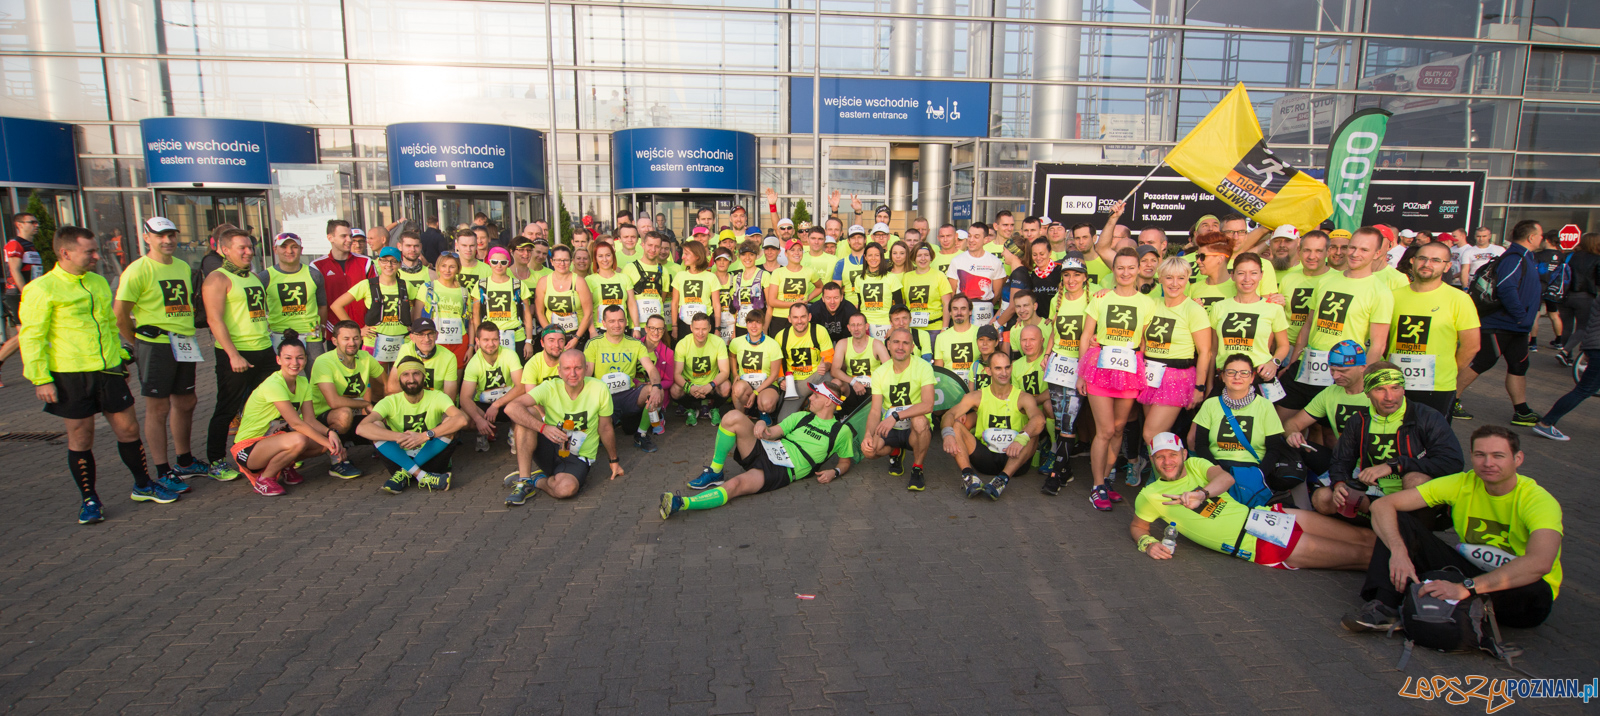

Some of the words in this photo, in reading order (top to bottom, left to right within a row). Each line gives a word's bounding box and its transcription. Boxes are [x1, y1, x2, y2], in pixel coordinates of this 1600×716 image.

[824, 95, 862, 109] wejście
[864, 97, 919, 109] wschodnie
[1280, 102, 1306, 115] RETRO
[839, 110, 871, 119] eastern
[872, 111, 908, 120] entrance
[148, 138, 182, 154] wejście
[185, 139, 260, 153] wschodnie
[400, 143, 437, 158] wejście
[440, 144, 506, 157] wschodnie
[635, 147, 674, 162] wejście
[677, 147, 734, 161] wschodnie
[160, 155, 195, 166] eastern
[197, 155, 247, 166] entrance
[414, 159, 449, 169] eastern
[450, 160, 495, 169] entrance
[650, 163, 684, 173] eastern
[686, 164, 724, 173] entrance
[1336, 131, 1379, 217] 4:00
[1236, 176, 1267, 197] night
[1143, 192, 1180, 200] Pozostaw
[1180, 192, 1198, 202] swój
[1199, 193, 1215, 201] ślad
[1221, 178, 1266, 210] runners
[1065, 201, 1075, 209] 18.
[1076, 201, 1093, 209] PKO
[1216, 184, 1259, 216] GLIWICE
[1151, 202, 1186, 210] Poznaniu
[1376, 203, 1396, 214] posir
[1560, 233, 1579, 241] STOP
[253, 310, 266, 318] nigh
[1320, 320, 1339, 329] night
[440, 326, 459, 335] 5397
[1111, 328, 1130, 336] night
[1062, 339, 1079, 347] night
[1105, 334, 1133, 342] runners
[1228, 338, 1249, 346] night
[178, 342, 192, 351] 563
[381, 344, 400, 352] 4255
[1401, 342, 1421, 350] night
[601, 352, 632, 363] RUN
[1110, 356, 1130, 368] 948
[1054, 363, 1075, 376] 1584
[1402, 367, 1426, 378] 031
[606, 379, 627, 389] 7326
[990, 434, 1013, 442] 4673
[1471, 546, 1511, 568] 6018
